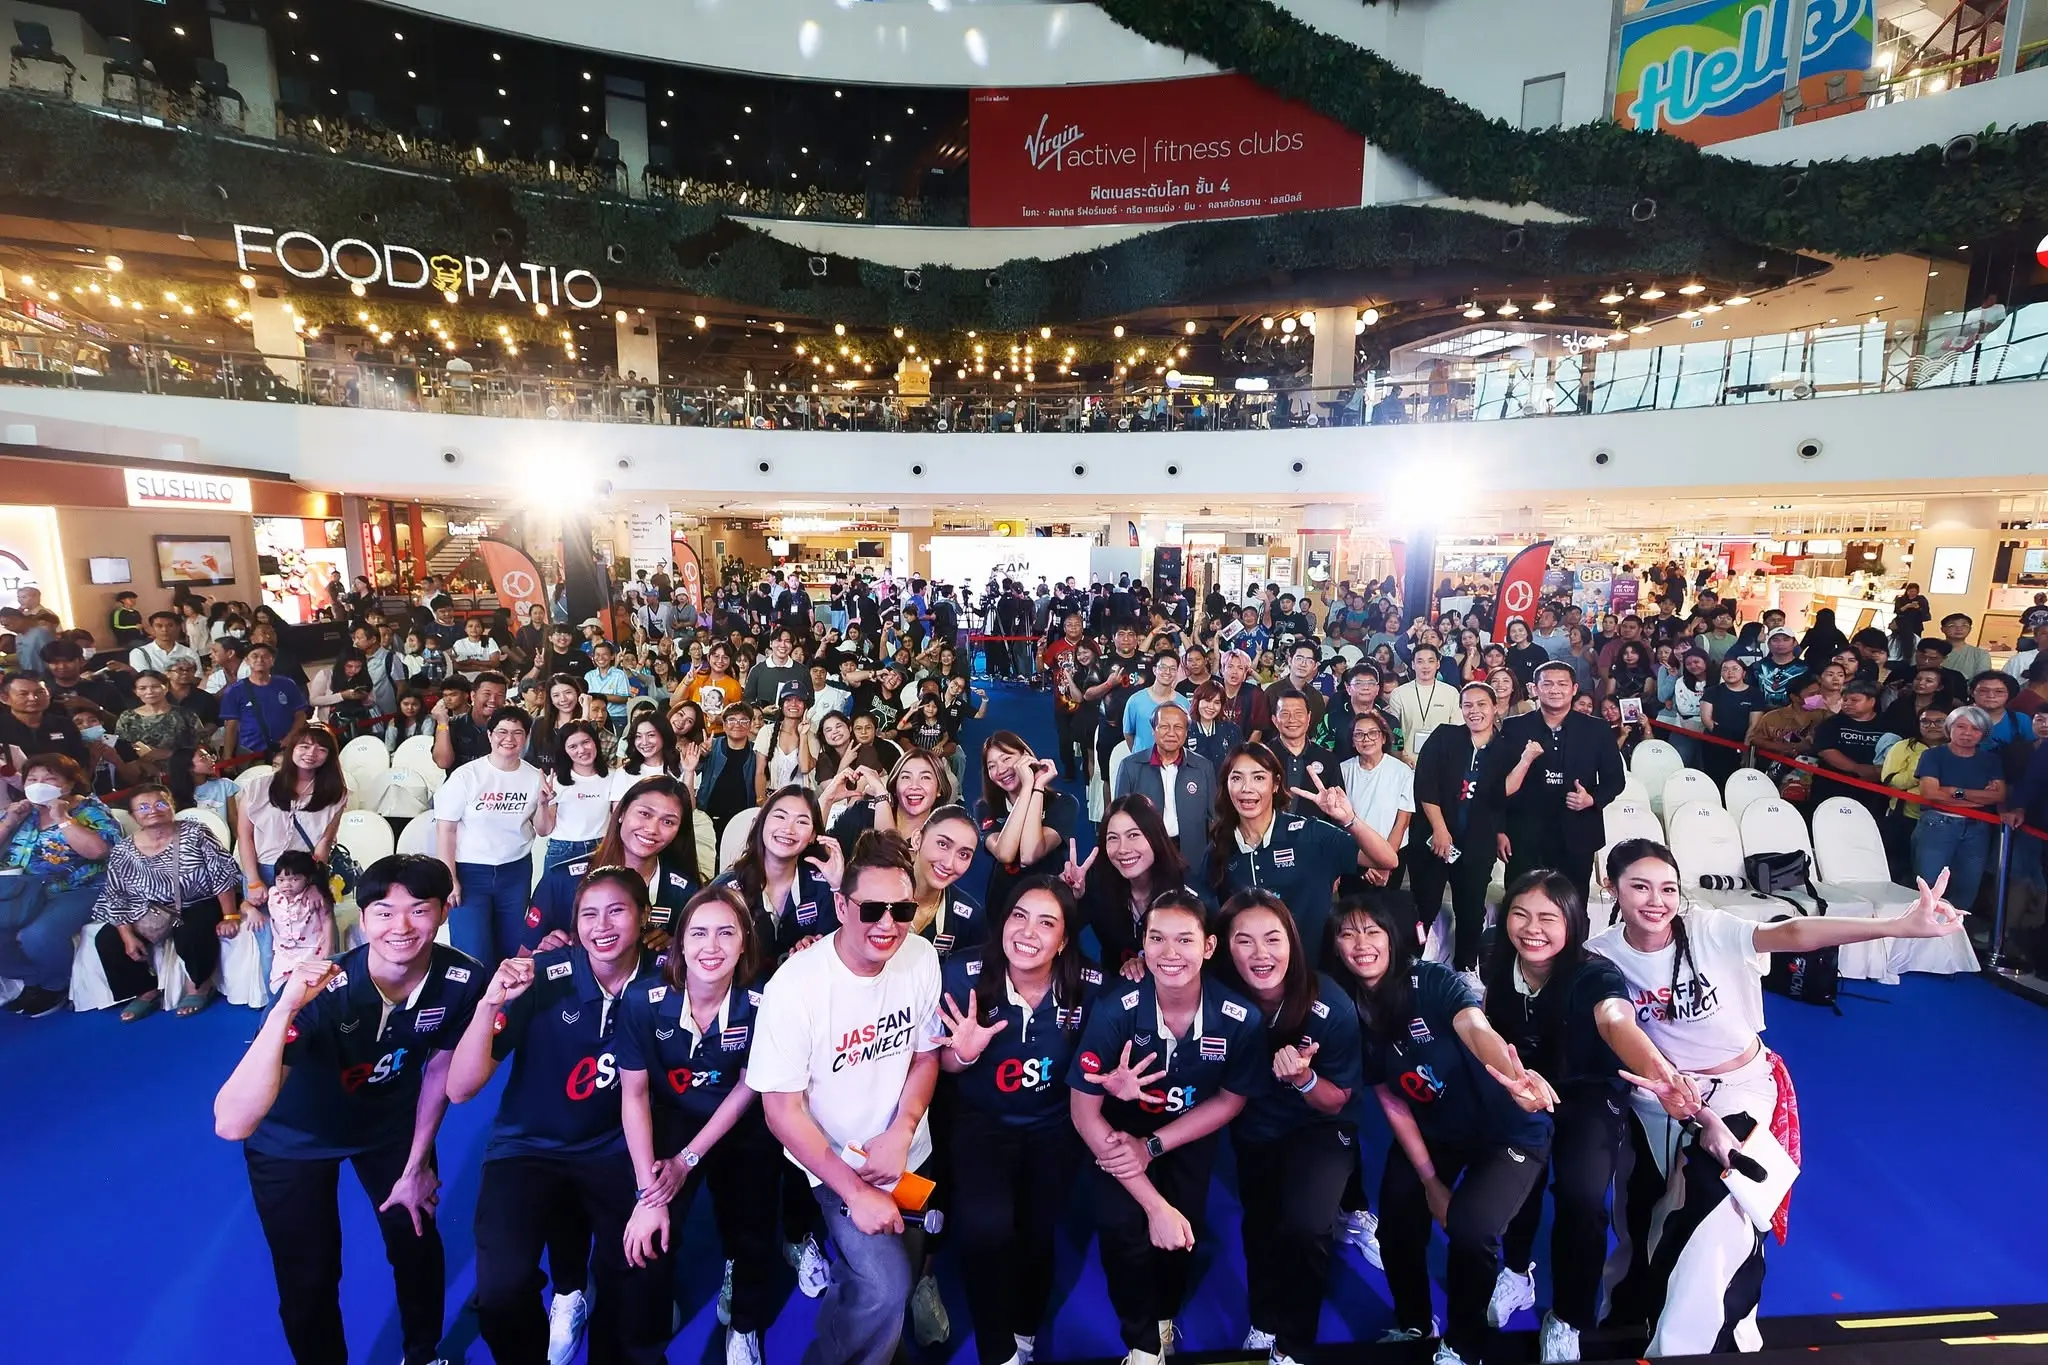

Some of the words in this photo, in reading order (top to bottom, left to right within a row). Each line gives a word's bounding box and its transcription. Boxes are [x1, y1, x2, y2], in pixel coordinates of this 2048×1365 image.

[1024, 113, 1085, 171] Virgin
[1067, 143, 1136, 167] active
[1154, 139, 1231, 163] fitness
[1239, 129, 1304, 156] clubs
[1090, 179, 1190, 200] ฟิตเนสระดับโลก
[1196, 176, 1214, 194] ชั้น
[1220, 178, 1230, 192] 4
[233, 223, 429, 288] FOOD
[464, 257, 602, 308] PATIO
[137, 477, 234, 501] SUSHIRO
[479, 792, 528, 802] JASFAN
[954, 904, 969, 914] PEA
[329, 975, 348, 990] PEA
[449, 969, 470, 981] PEA
[550, 966, 569, 977] PEA
[651, 990, 664, 999] PE
[1224, 1004, 1243, 1018] PEA
[836, 1006, 911, 1052] JASFAN
[832, 1025, 916, 1073] CONNECT
[566, 1053, 617, 1101] es
[995, 1056, 1054, 1093] est
